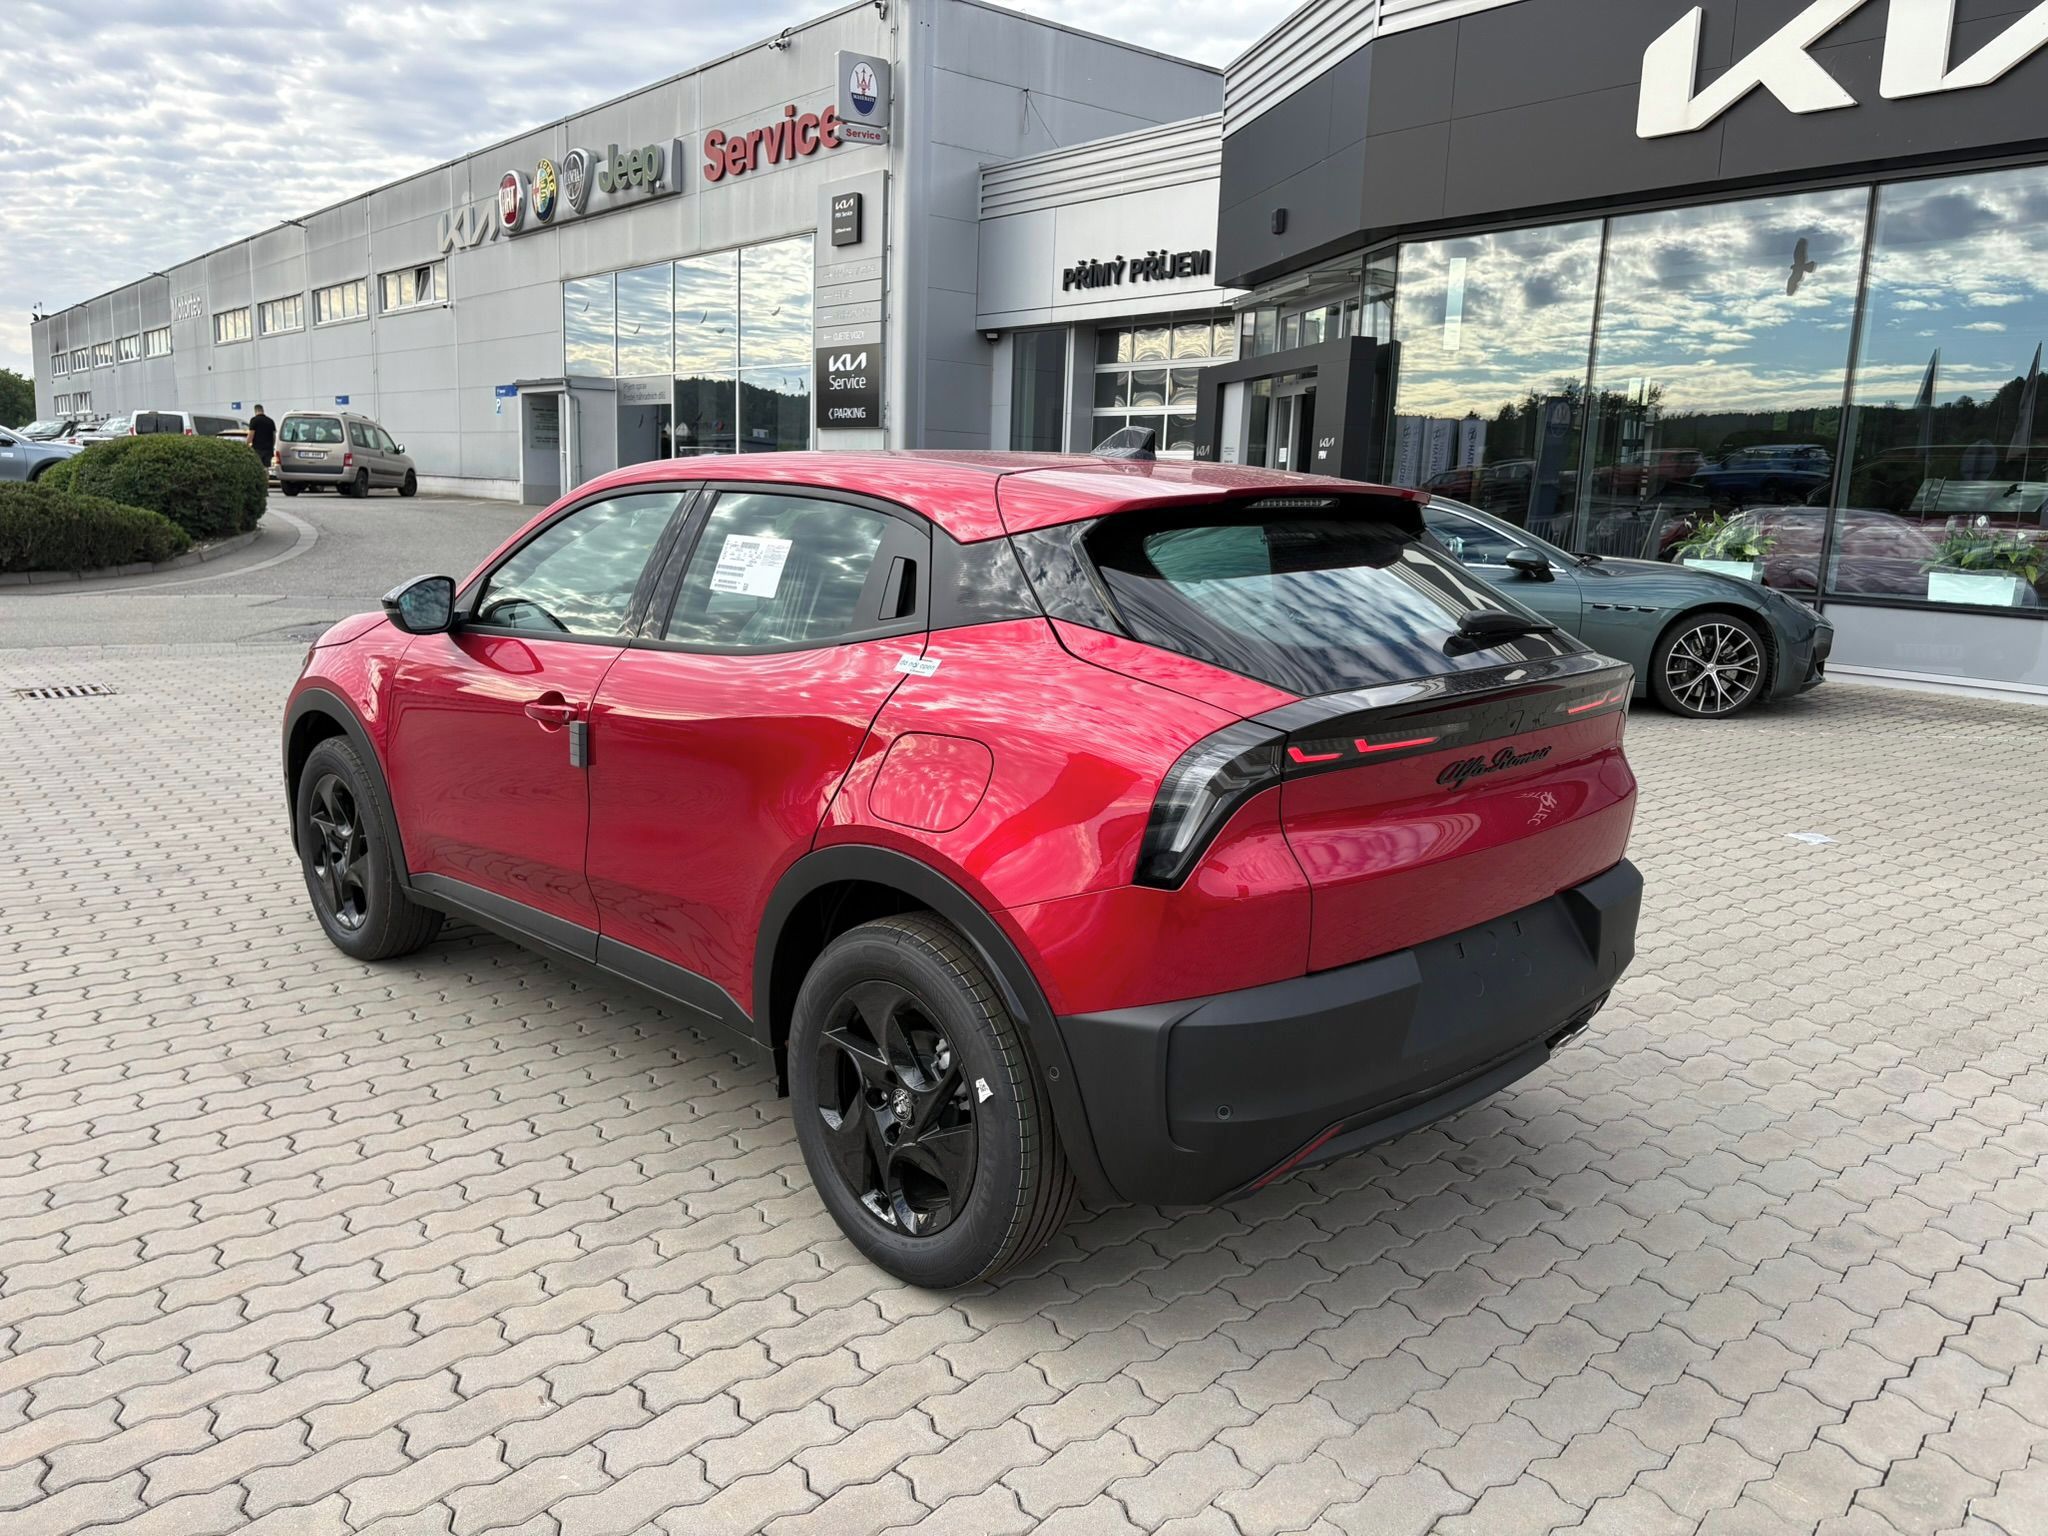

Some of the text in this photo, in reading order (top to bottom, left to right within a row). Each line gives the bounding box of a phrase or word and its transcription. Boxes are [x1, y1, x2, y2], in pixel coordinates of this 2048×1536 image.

[703, 104, 843, 182] Service
[845, 128, 881, 141] Service
[599, 144, 664, 194] Jeep
[835, 198, 854, 210] KIA
[1062, 249, 1212, 291] PŘÍMÝ PŘÍJEM
[828, 352, 867, 372] KIA
[828, 373, 867, 390] Service
[833, 406, 867, 419] PARKING
[1196, 445, 1210, 456] KIA
[1319, 437, 1335, 448] KIA
[1435, 745, 1552, 793] Alfa Romeo
